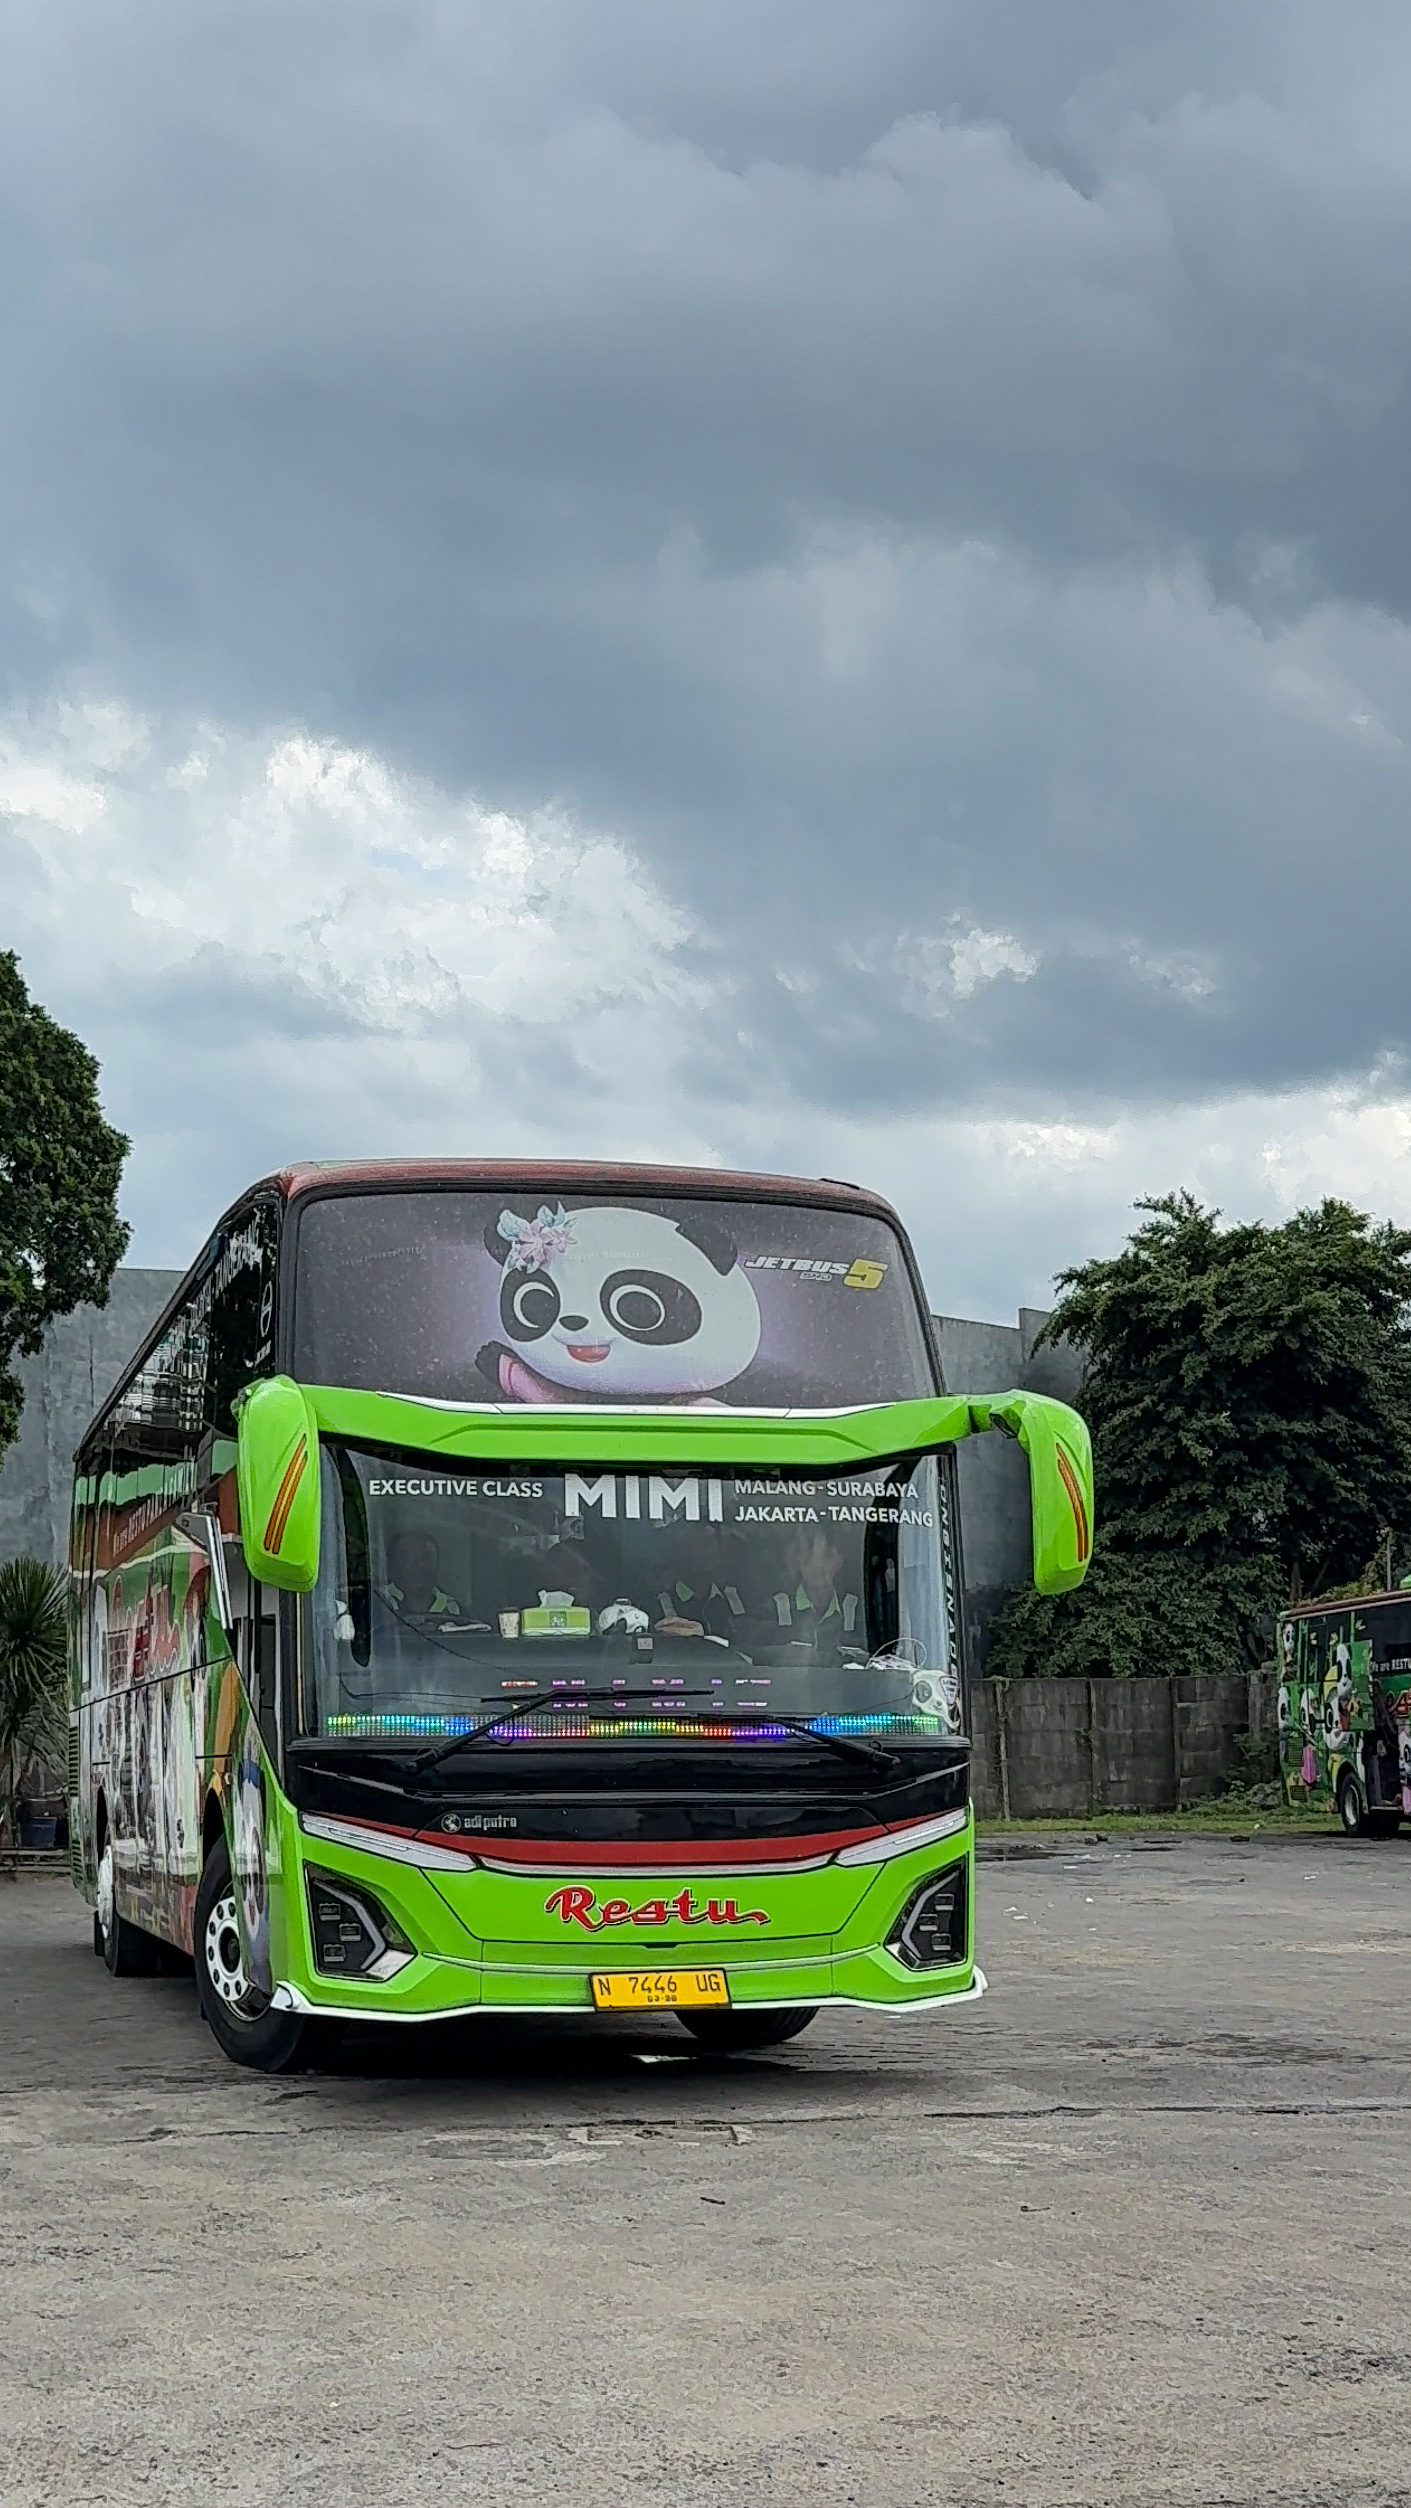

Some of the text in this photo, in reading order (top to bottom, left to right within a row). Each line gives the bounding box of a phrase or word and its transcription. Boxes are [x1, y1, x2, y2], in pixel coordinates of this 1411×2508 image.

[369, 1480, 544, 1498] EXECUTIVE CLASS
[565, 1473, 723, 1522] MIMI
[545, 1884, 771, 1932] Restu
[598, 1973, 721, 1996] N 7446 UG
